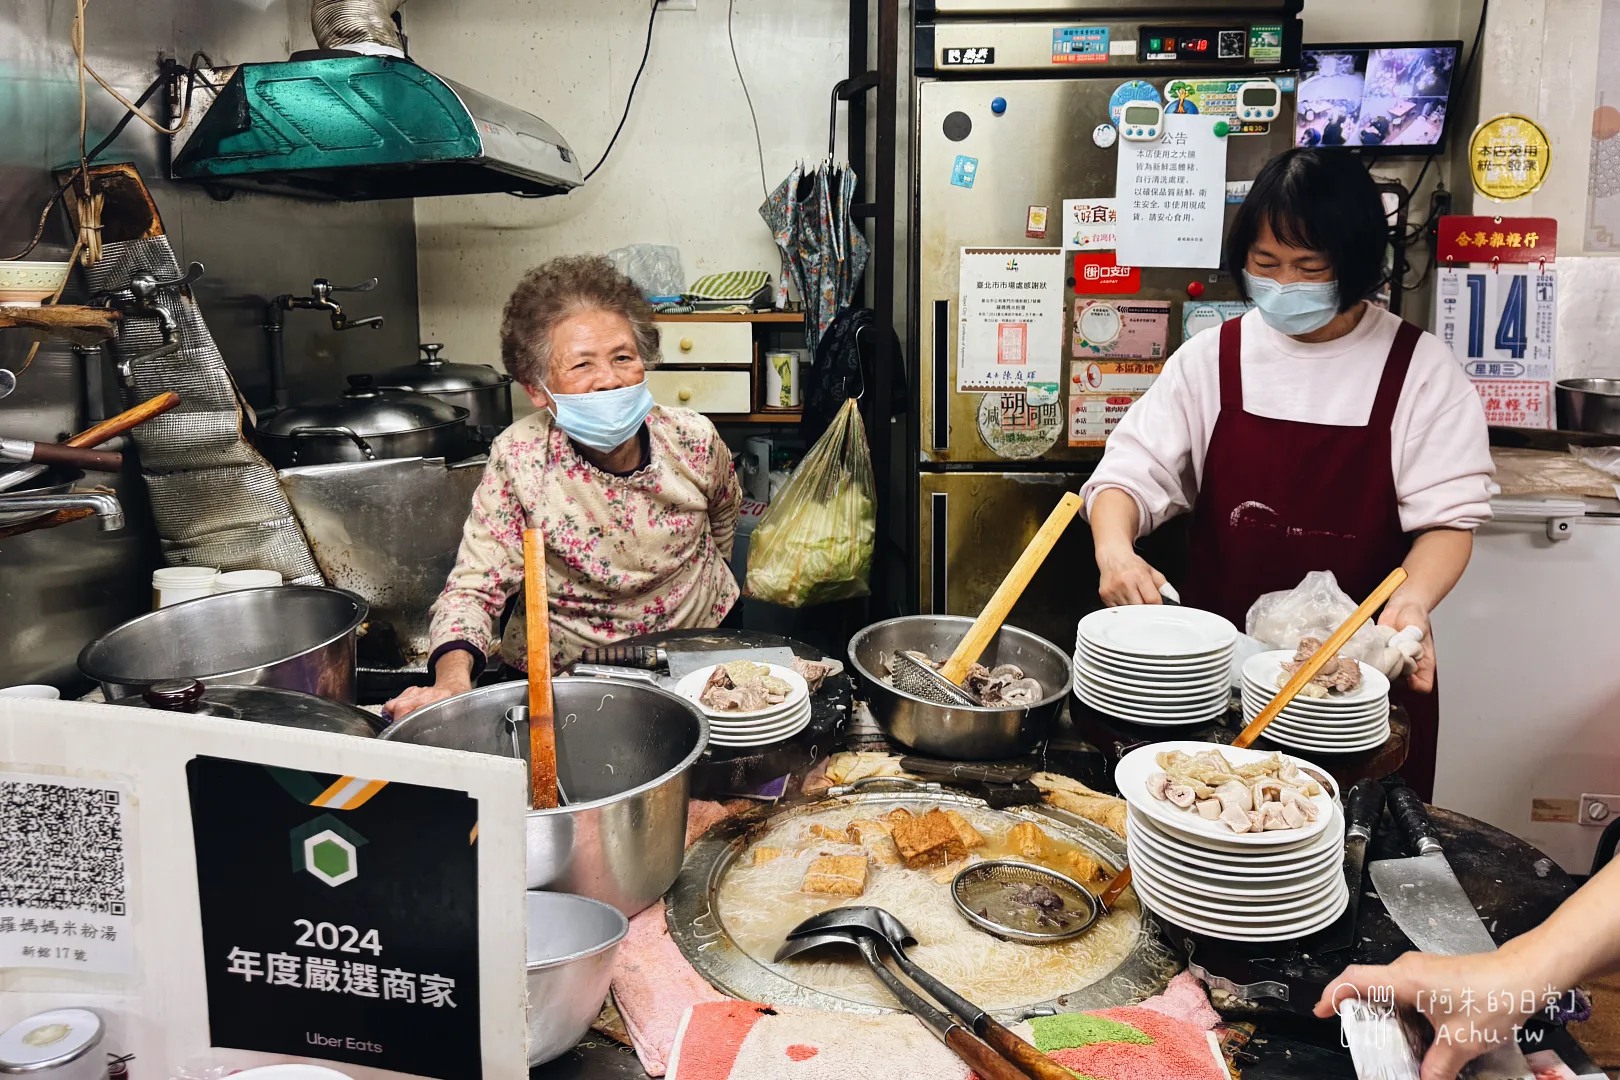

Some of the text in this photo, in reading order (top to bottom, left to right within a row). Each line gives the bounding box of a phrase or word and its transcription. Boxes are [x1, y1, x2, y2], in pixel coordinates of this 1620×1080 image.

[1160, 132, 1188, 145] 公告
[1136, 150, 1196, 159] 本店使用之大腸
[1477, 160, 1538, 171] 統一發票
[1085, 265, 1131, 279] 街口支付
[1466, 274, 1528, 359] 14
[1474, 363, 1516, 376] 星期三
[0, 916, 118, 942] 羅媽媽米粉湯
[293, 918, 383, 956] 2024
[227, 946, 458, 1009] 年度嚴選商家
[305, 1031, 383, 1053] Uber Eats
